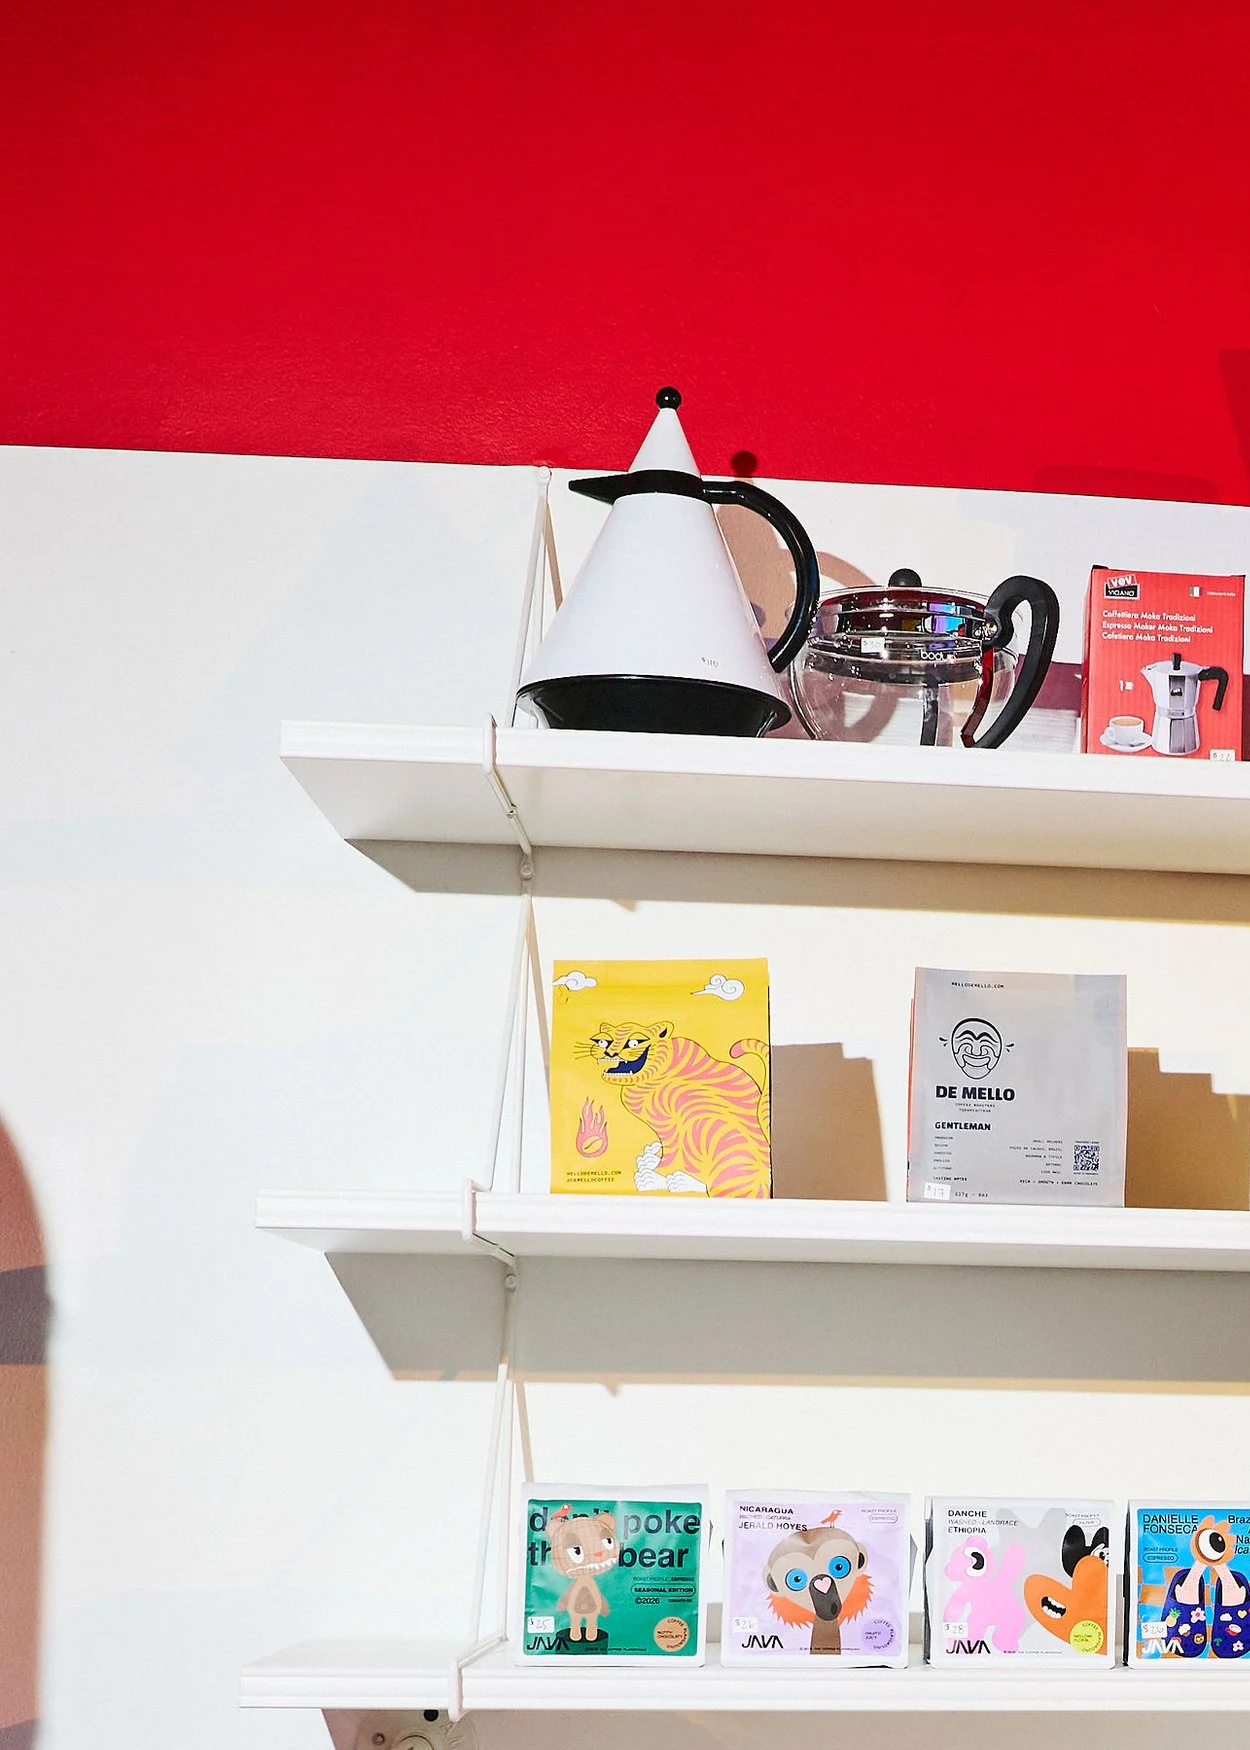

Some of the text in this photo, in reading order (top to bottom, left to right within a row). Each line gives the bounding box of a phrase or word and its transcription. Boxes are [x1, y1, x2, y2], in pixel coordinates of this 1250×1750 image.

[1140, 611, 1161, 620] Moka
[1162, 613, 1196, 622] Tradizioni
[1102, 621, 1214, 634] Espresso Maker Moka Tradizioni
[1135, 633, 1156, 642] Moka
[1157, 634, 1192, 644] Tradizioni
[936, 1085, 1015, 1102] DE MELLO
[934, 1121, 991, 1131] GENTLEMAN
[739, 1505, 794, 1515] NICARAGUA
[947, 1509, 988, 1518] DANCHE
[623, 1508, 701, 1540] poke
[1142, 1513, 1199, 1525] DANIELLE
[738, 1521, 808, 1532] JERALD HOYES
[948, 1526, 987, 1534] ETHIOPIA
[1143, 1523, 1198, 1535] FONSECA
[528, 1540, 689, 1568] th bear
[526, 1636, 570, 1651] JAVA
[741, 1634, 784, 1649] JAVA
[946, 1639, 991, 1654] JAVA
[1142, 1638, 1185, 1654] JAVA
